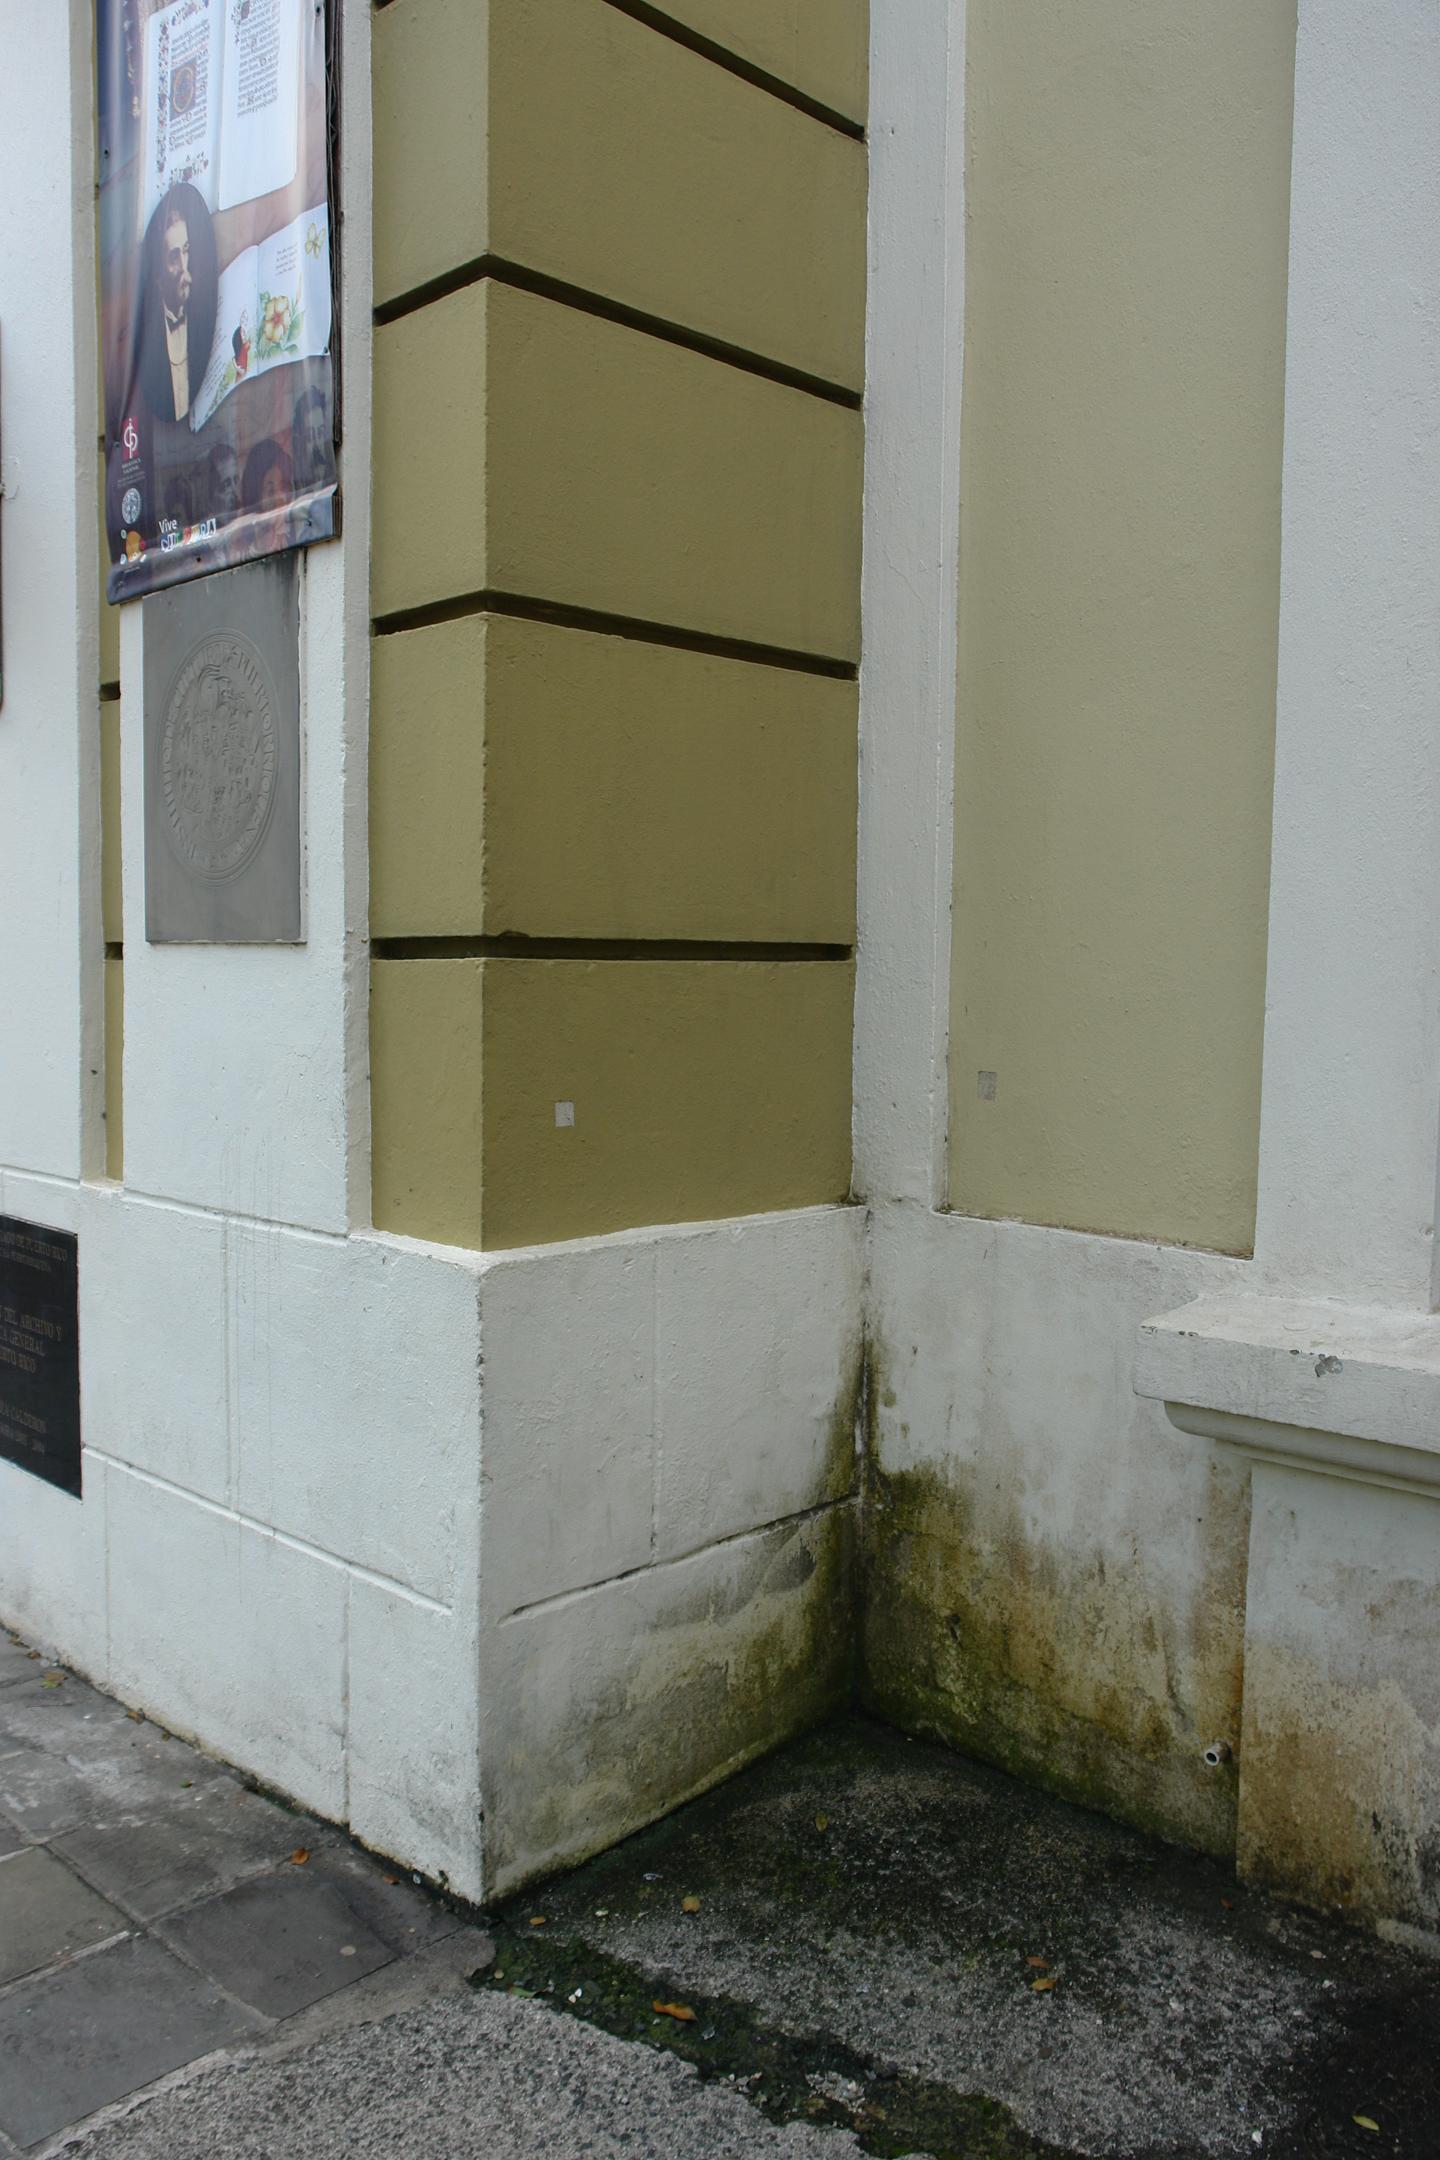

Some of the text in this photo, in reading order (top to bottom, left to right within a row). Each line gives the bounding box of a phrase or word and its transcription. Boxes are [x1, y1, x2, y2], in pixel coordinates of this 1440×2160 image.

[158, 518, 178, 533] Vive
[55, 1325, 63, 1342] Y
[10, 1328, 46, 1357] GENERAL
